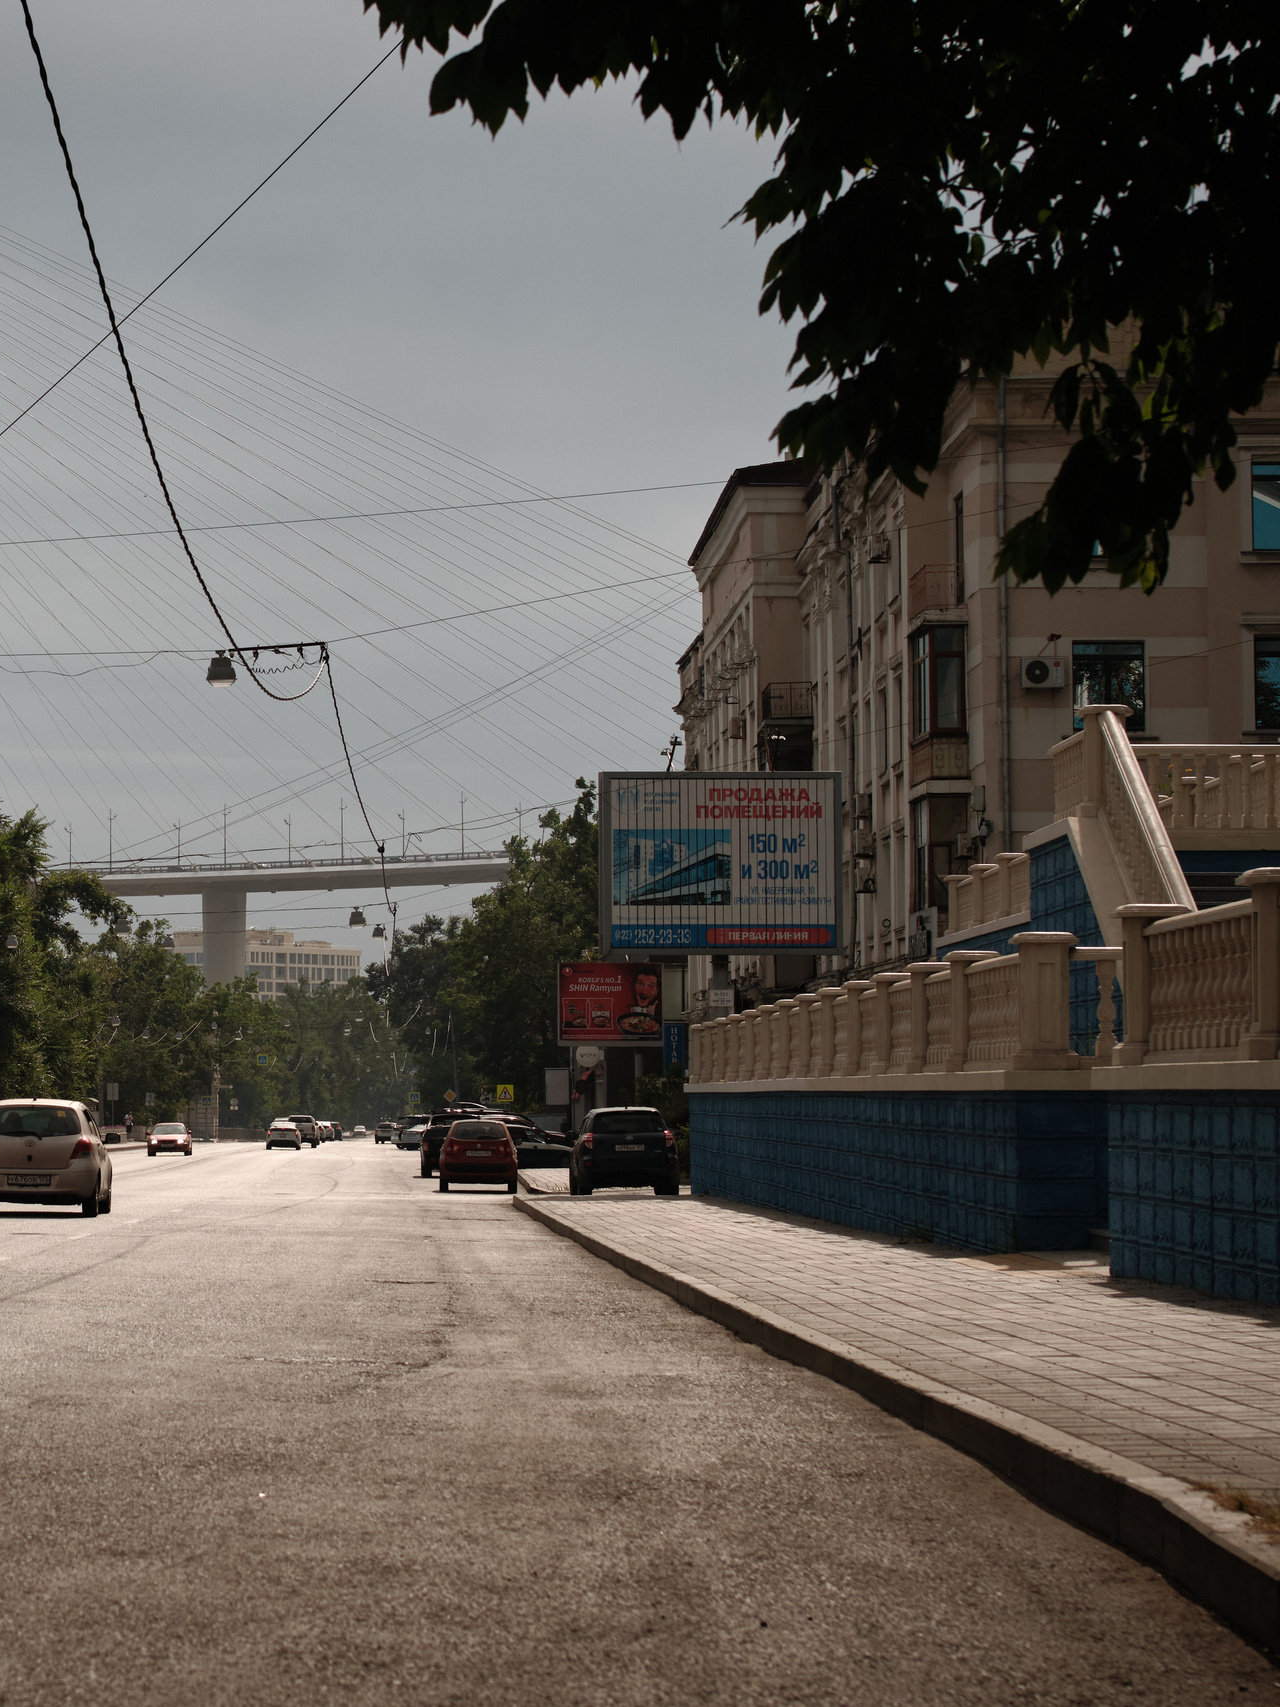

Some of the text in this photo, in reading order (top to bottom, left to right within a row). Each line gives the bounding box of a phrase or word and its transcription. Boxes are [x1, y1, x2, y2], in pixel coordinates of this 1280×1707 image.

[709, 787, 810, 804] ПРОДАЖА
[696, 802, 822, 821] ПОМЕЩЕНИЙ
[749, 833, 777, 853] 150
[757, 860, 789, 879] 300
[634, 929, 691, 943] 252-23-33
[728, 931, 808, 940] ПЕРВАЯ ЛИНИЯ
[569, 984, 622, 993] SHIN Ramyun
